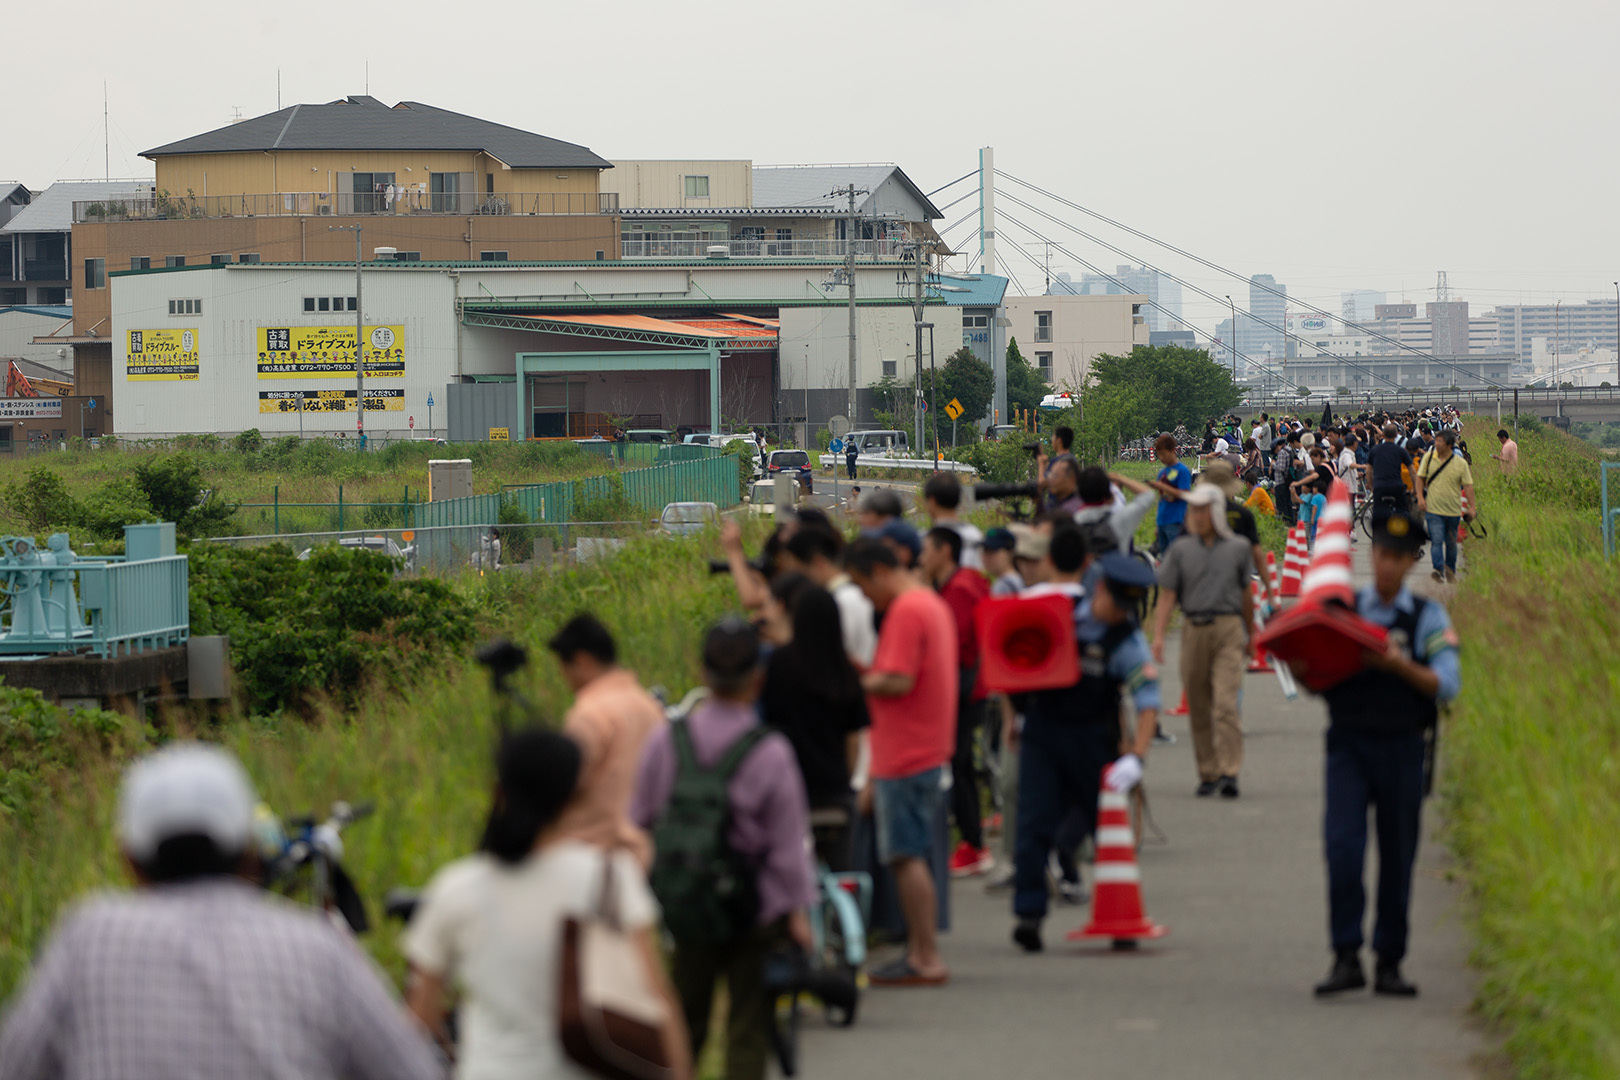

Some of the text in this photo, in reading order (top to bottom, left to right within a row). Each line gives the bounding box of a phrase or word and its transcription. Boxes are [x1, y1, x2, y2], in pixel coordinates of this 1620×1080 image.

[268, 330, 288, 340] 古着
[146, 341, 180, 352] ドライブスルー
[268, 340, 289, 350] 買取
[297, 338, 366, 350] ドライブスルー
[58, 388, 69, 396] CAT
[279, 398, 385, 411] 着らない洋服・製品
